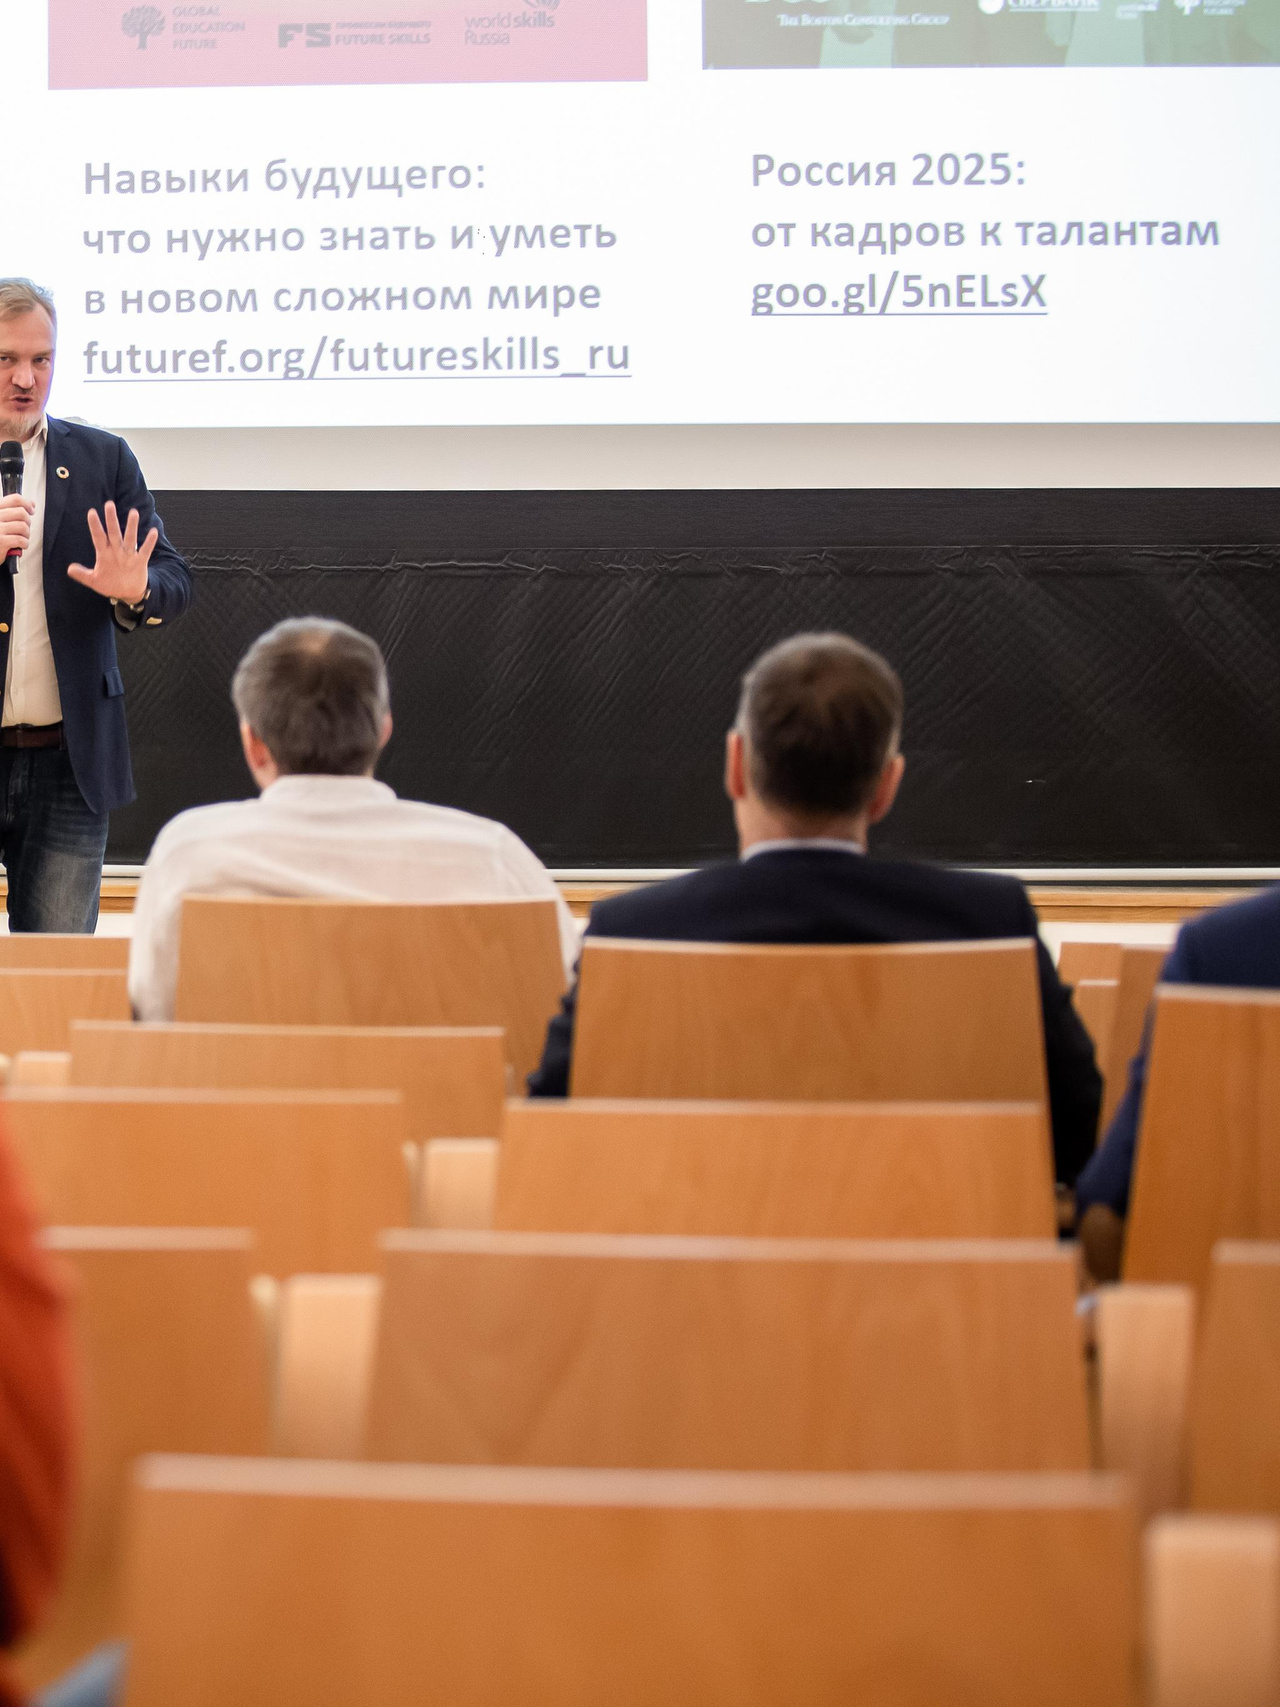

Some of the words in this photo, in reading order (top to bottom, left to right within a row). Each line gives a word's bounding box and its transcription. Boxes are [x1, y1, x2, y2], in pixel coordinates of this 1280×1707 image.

[172, 5, 220, 17] GLOBAL
[172, 21, 246, 33] EDUCATION
[172, 38, 217, 50] FUTURE
[278, 22, 331, 48] FS
[335, 33, 385, 45] FUTURE
[388, 32, 431, 45] SKILLS
[464, 29, 510, 45] Russia
[84, 162, 249, 195] Навыки
[264, 158, 485, 200] будущего:
[752, 154, 897, 187] Россия
[912, 152, 1025, 186] 2025:
[82, 229, 151, 255] что
[166, 227, 305, 262] нужно
[319, 225, 437, 252] знать
[450, 224, 474, 250] и
[488, 223, 618, 258] уметь
[751, 222, 797, 248] от
[810, 221, 966, 256] кадров
[980, 221, 1003, 247] к
[1014, 220, 1221, 247] талантам
[84, 290, 106, 315] в
[120, 288, 259, 315] новом
[273, 285, 473, 313] сложном
[487, 284, 602, 318] мире
[751, 270, 1048, 315] goo.gl/5nELsX
[83, 335, 632, 381] futuref.org/futureskills_ru
